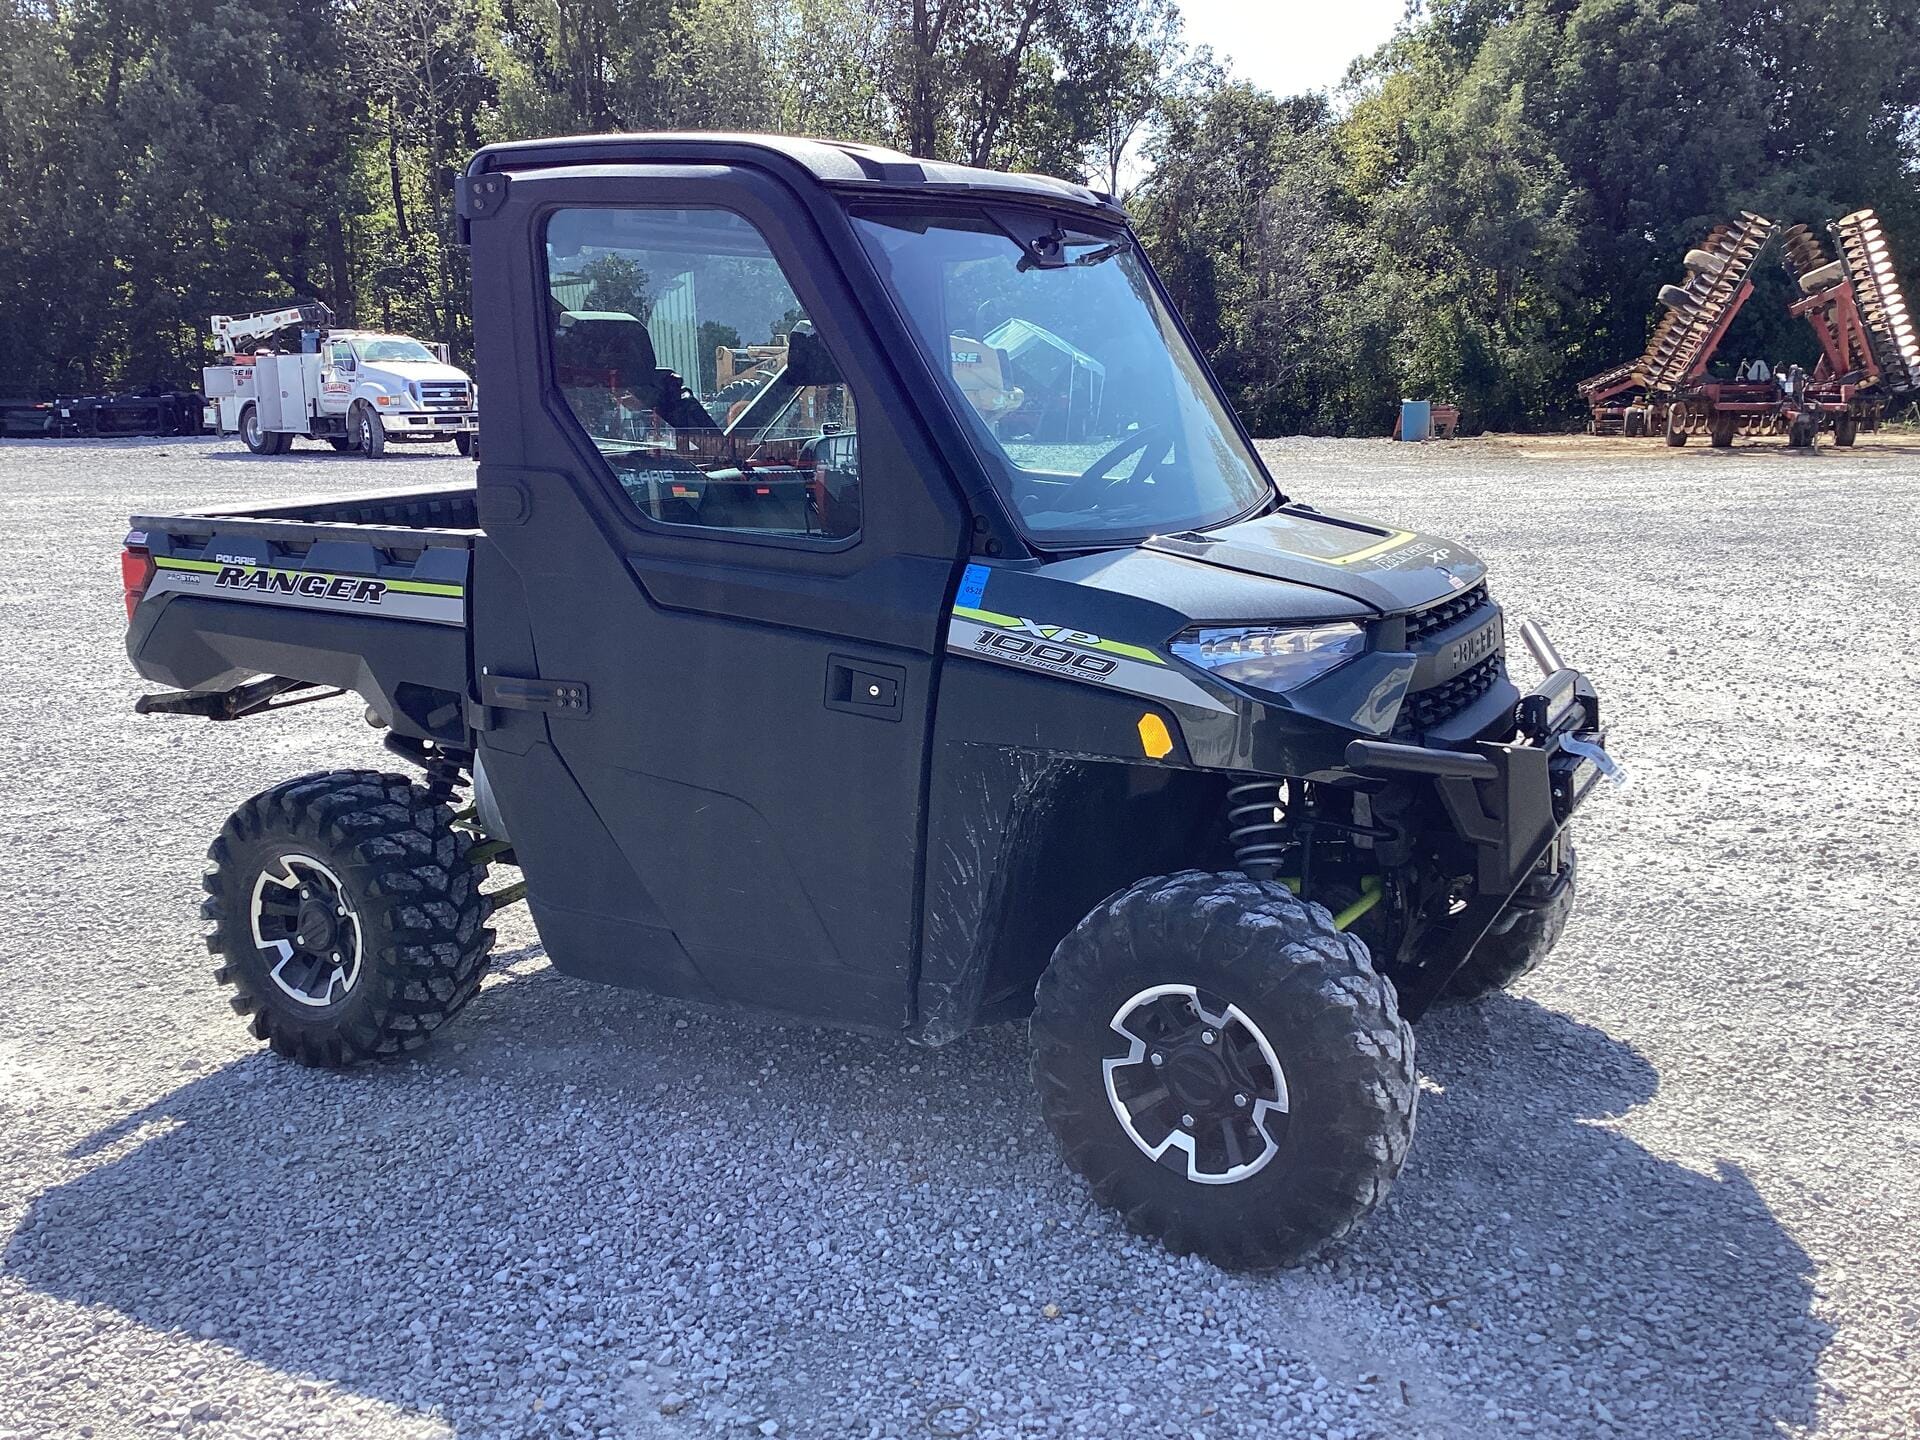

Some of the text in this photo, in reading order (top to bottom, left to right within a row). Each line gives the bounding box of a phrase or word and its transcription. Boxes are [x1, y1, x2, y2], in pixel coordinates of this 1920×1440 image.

[215, 554, 257, 566] POLARIS
[1375, 542, 1437, 571] RANGER
[1426, 548, 1450, 564] XP
[214, 566, 388, 604] RANGER
[1003, 616, 1102, 645] XP
[974, 628, 1118, 676] 1000
[974, 646, 1106, 682] DUAL OVERHEAD CAM
